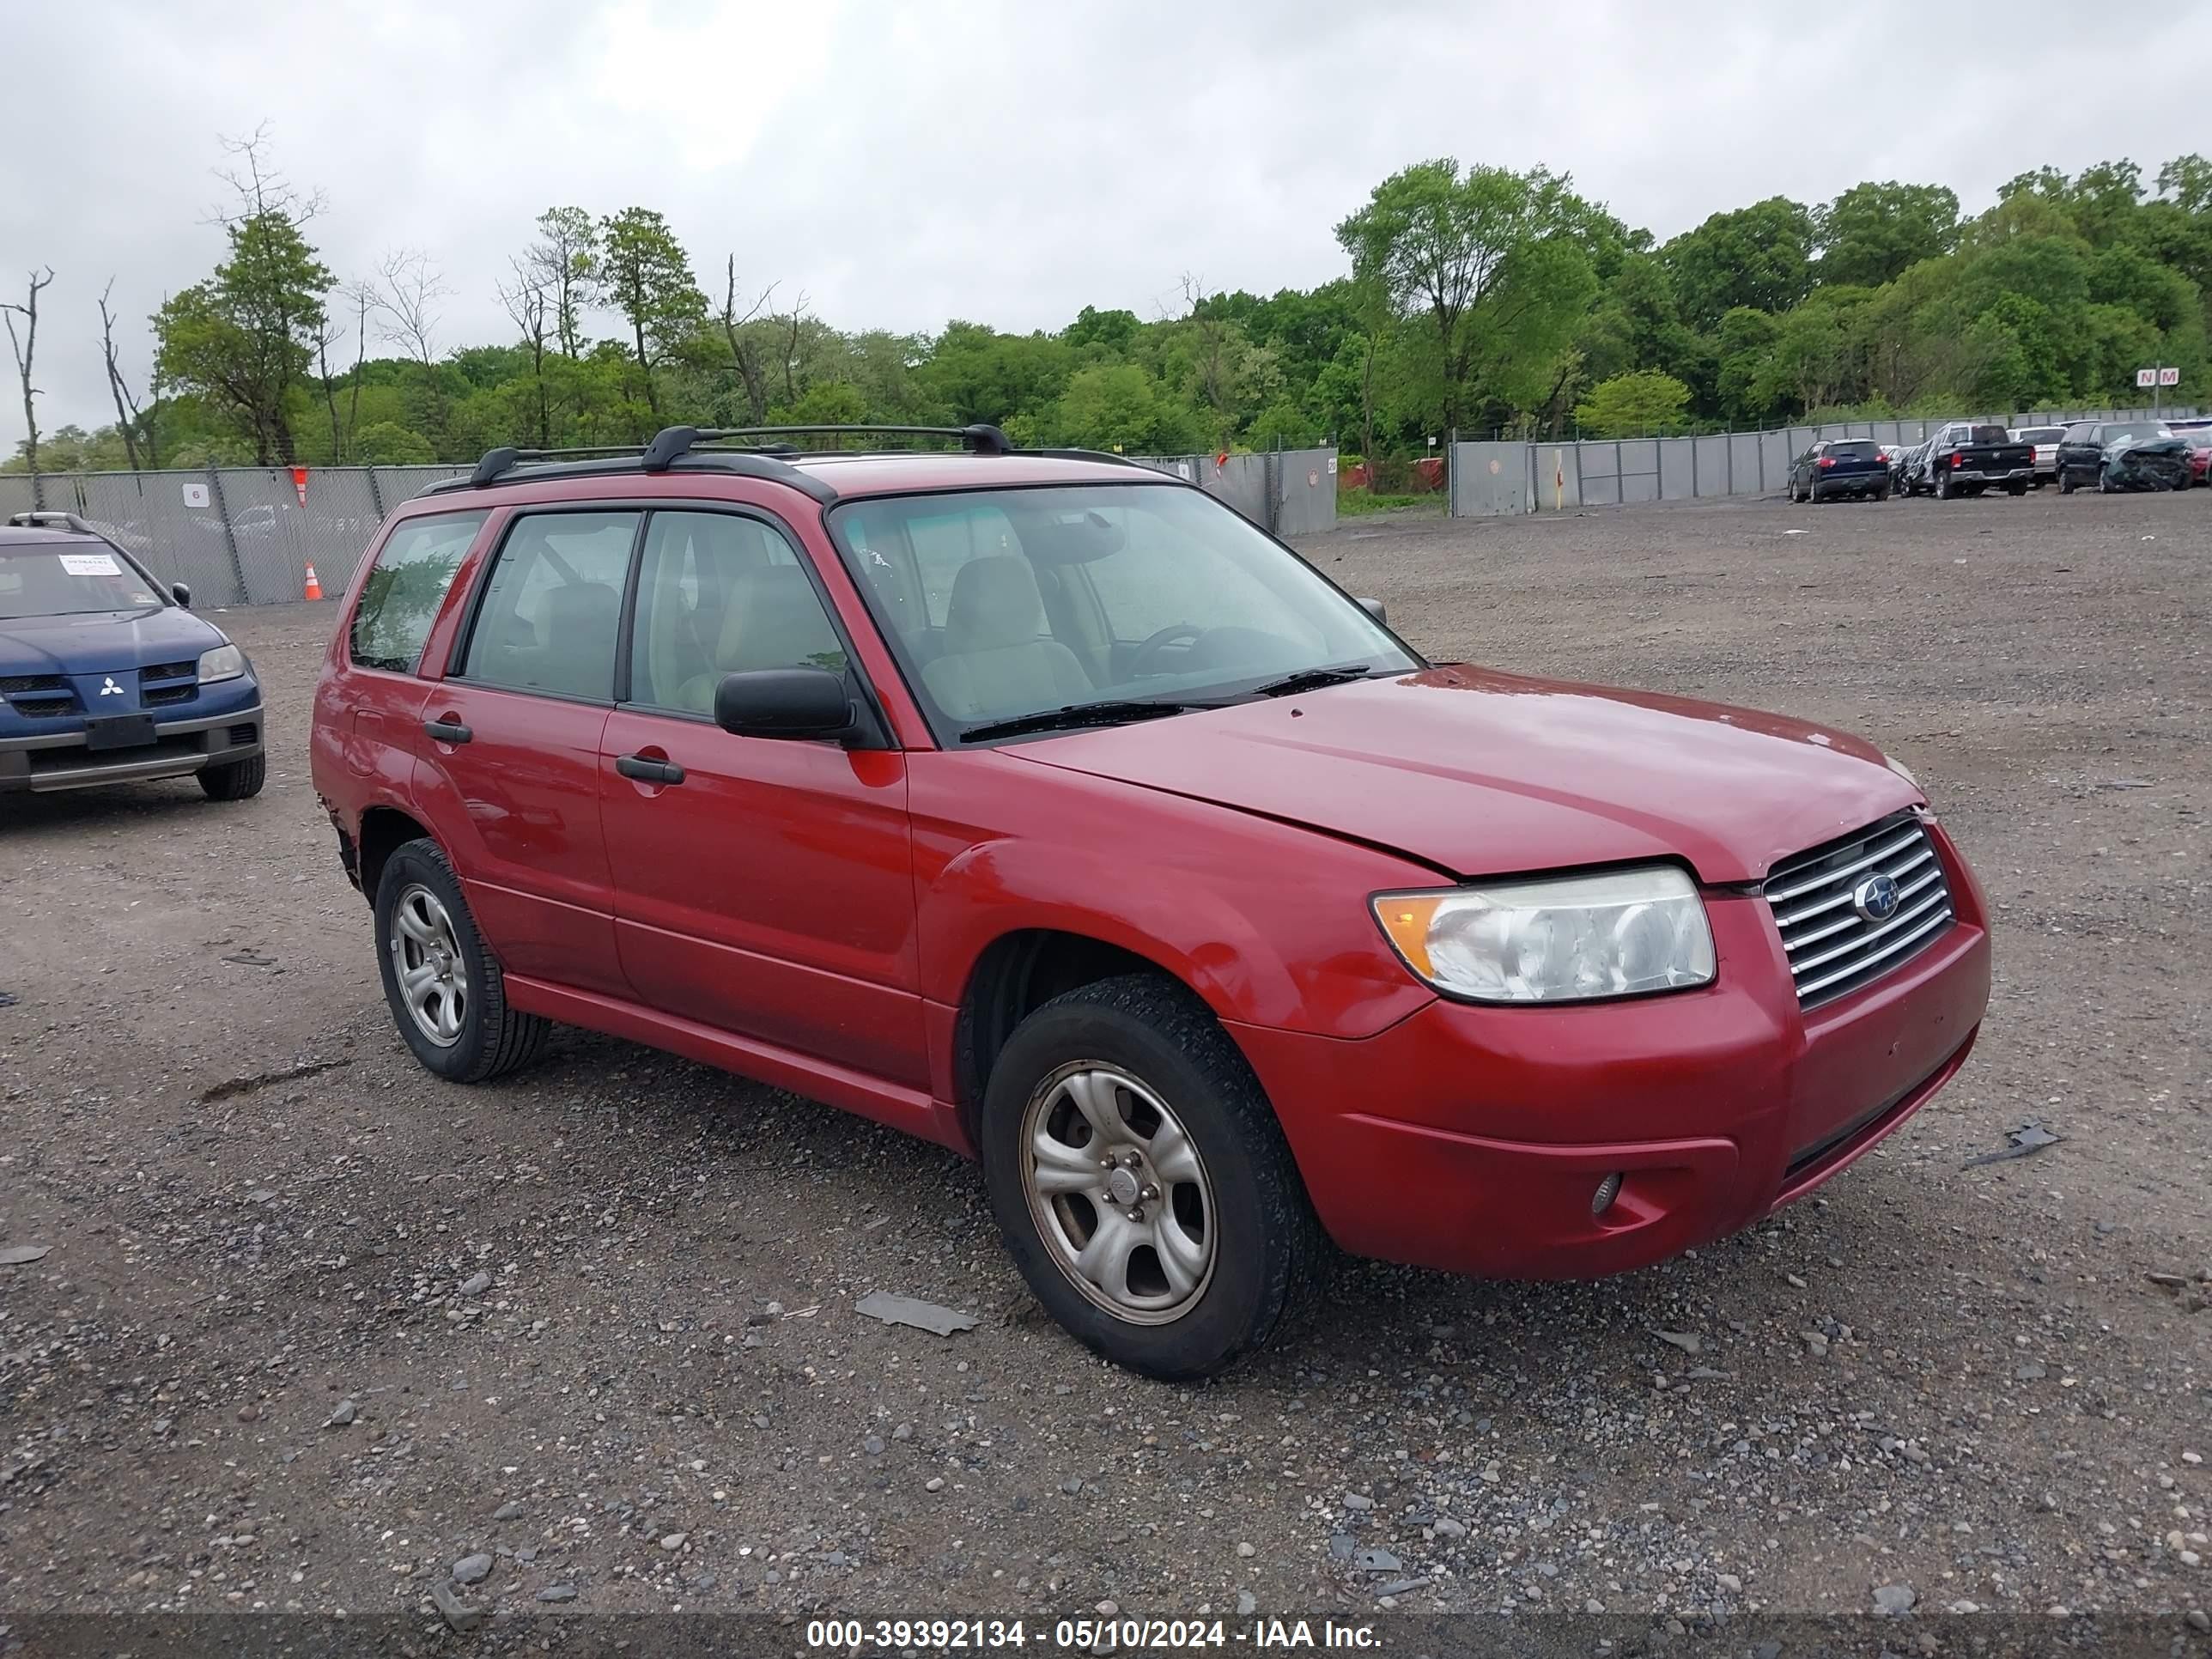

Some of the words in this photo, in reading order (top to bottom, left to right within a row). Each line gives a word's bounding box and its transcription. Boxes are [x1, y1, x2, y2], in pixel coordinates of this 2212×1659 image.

[2142, 371, 2153, 383] N
[2162, 371, 2177, 383] M
[1328, 460, 1336, 471] 20
[192, 490, 200, 499] 6
